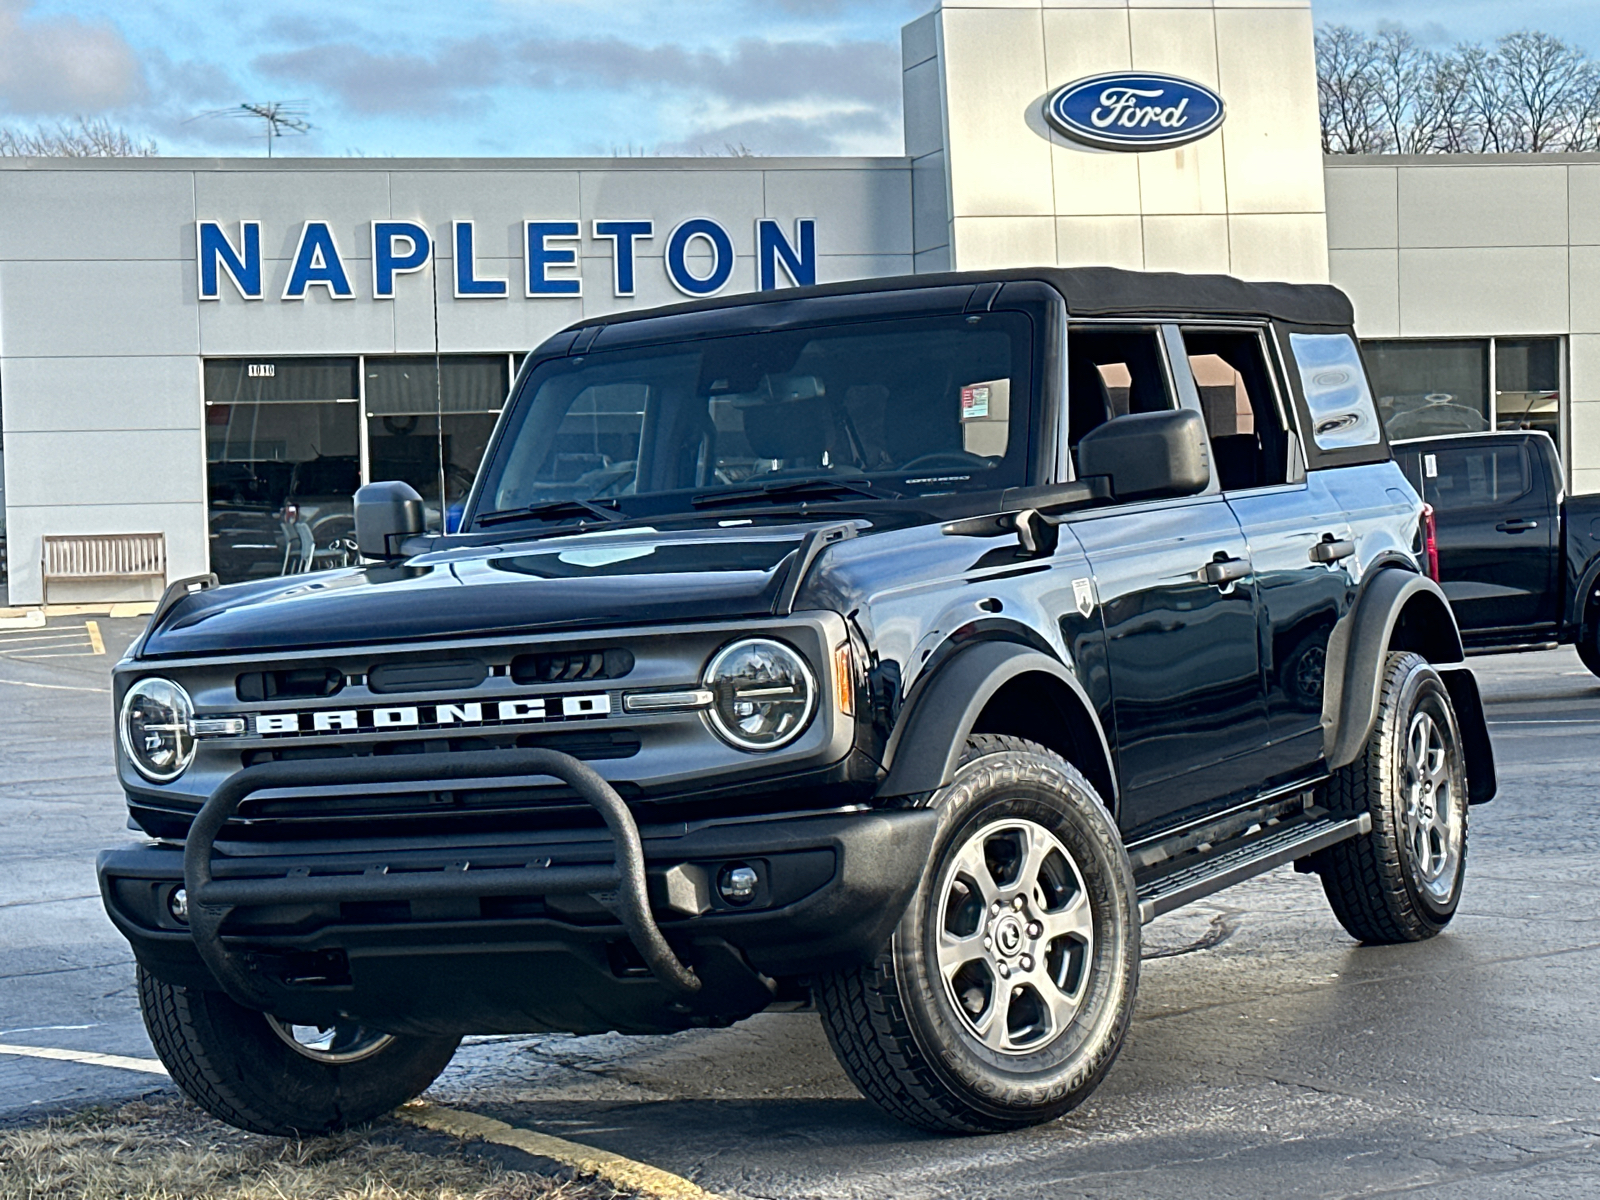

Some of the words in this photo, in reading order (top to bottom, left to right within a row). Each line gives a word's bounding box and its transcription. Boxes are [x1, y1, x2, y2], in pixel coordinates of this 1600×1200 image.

[1091, 88, 1189, 127] Ford
[196, 217, 817, 300] NAPLETON
[249, 364, 275, 377] 1010
[256, 694, 611, 735] BRONCO
